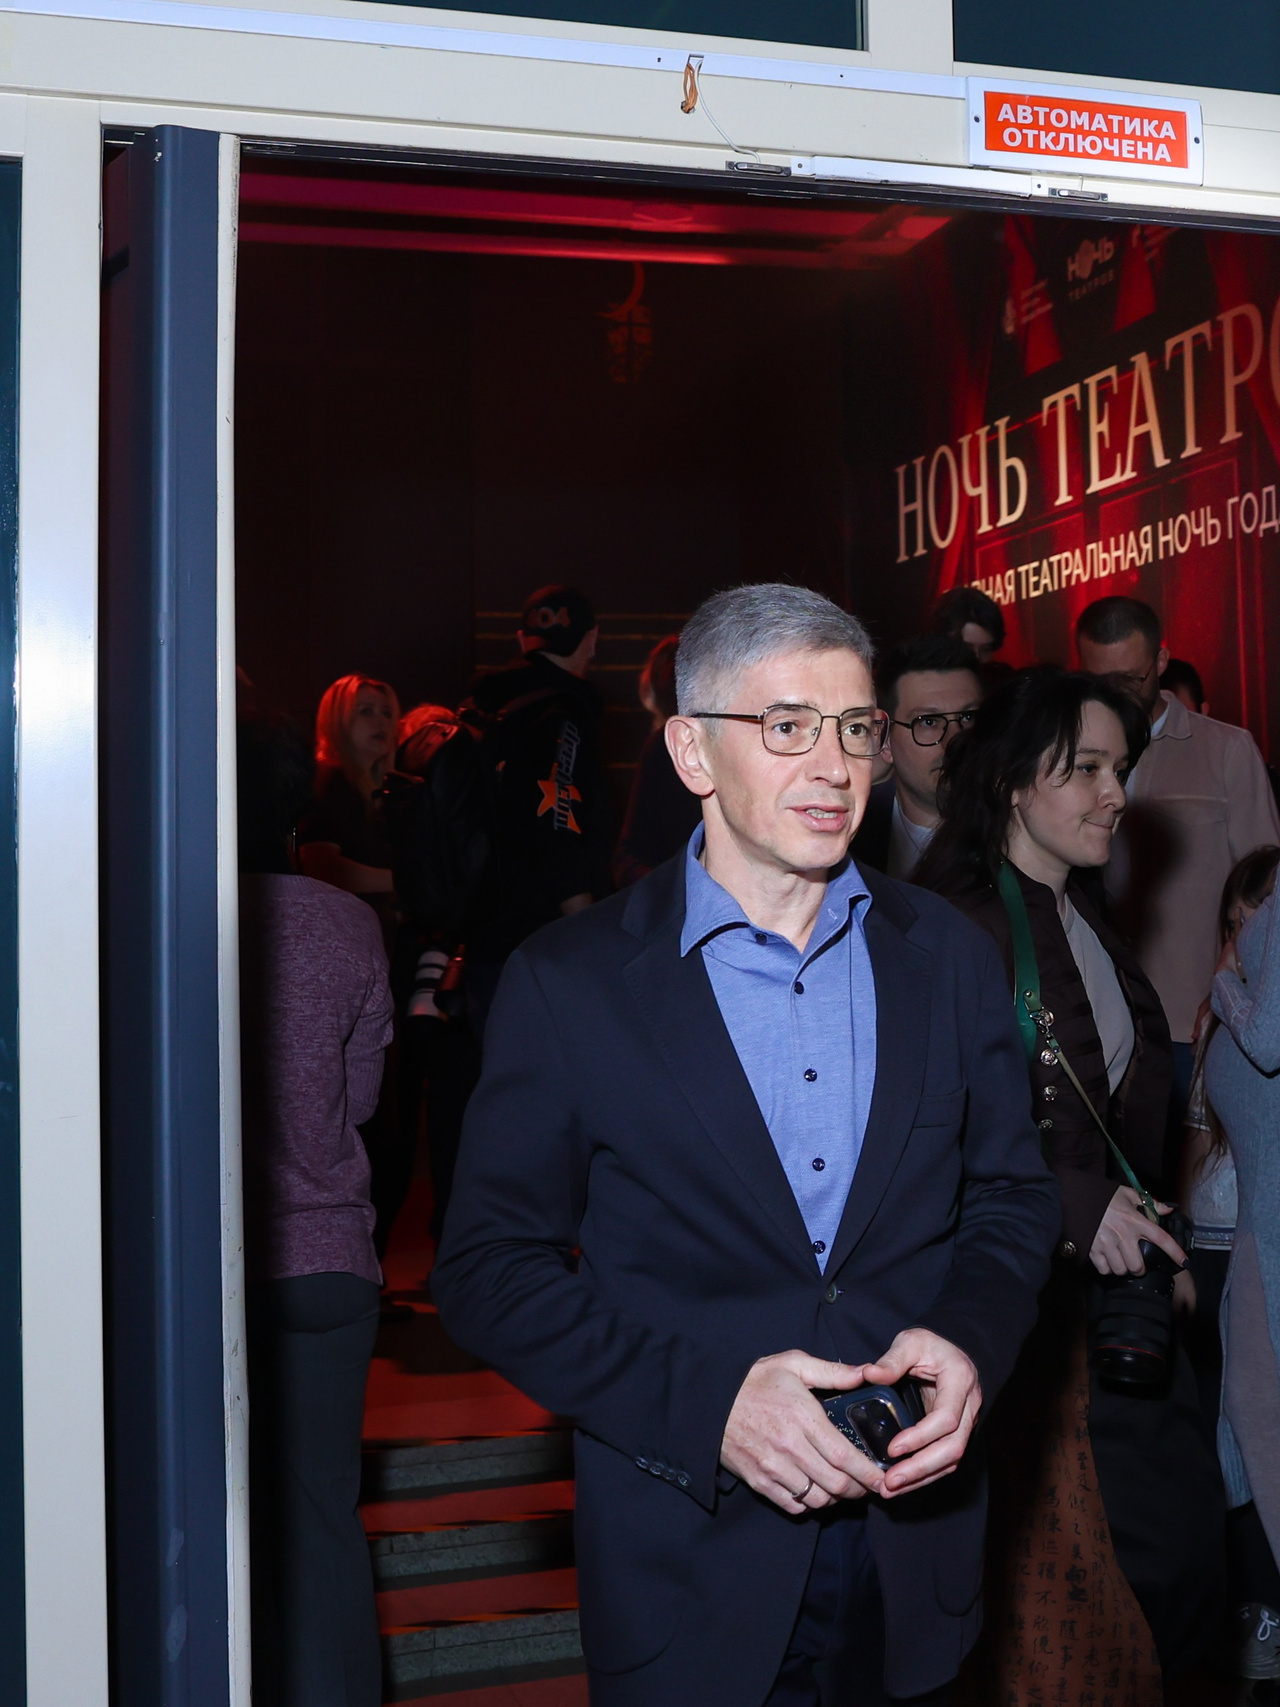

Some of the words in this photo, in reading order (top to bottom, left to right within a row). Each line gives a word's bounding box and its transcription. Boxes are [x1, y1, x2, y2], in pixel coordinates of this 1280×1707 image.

[997, 103, 1177, 141] АВТОМАТИКА
[1002, 127, 1172, 163] ОТКЛЮЧЕНА
[895, 414, 1028, 564] НОЧЬ
[1017, 525, 1153, 602] ТЕАТРАЛЬНАЯ
[1158, 506, 1222, 564] НОЧЬ
